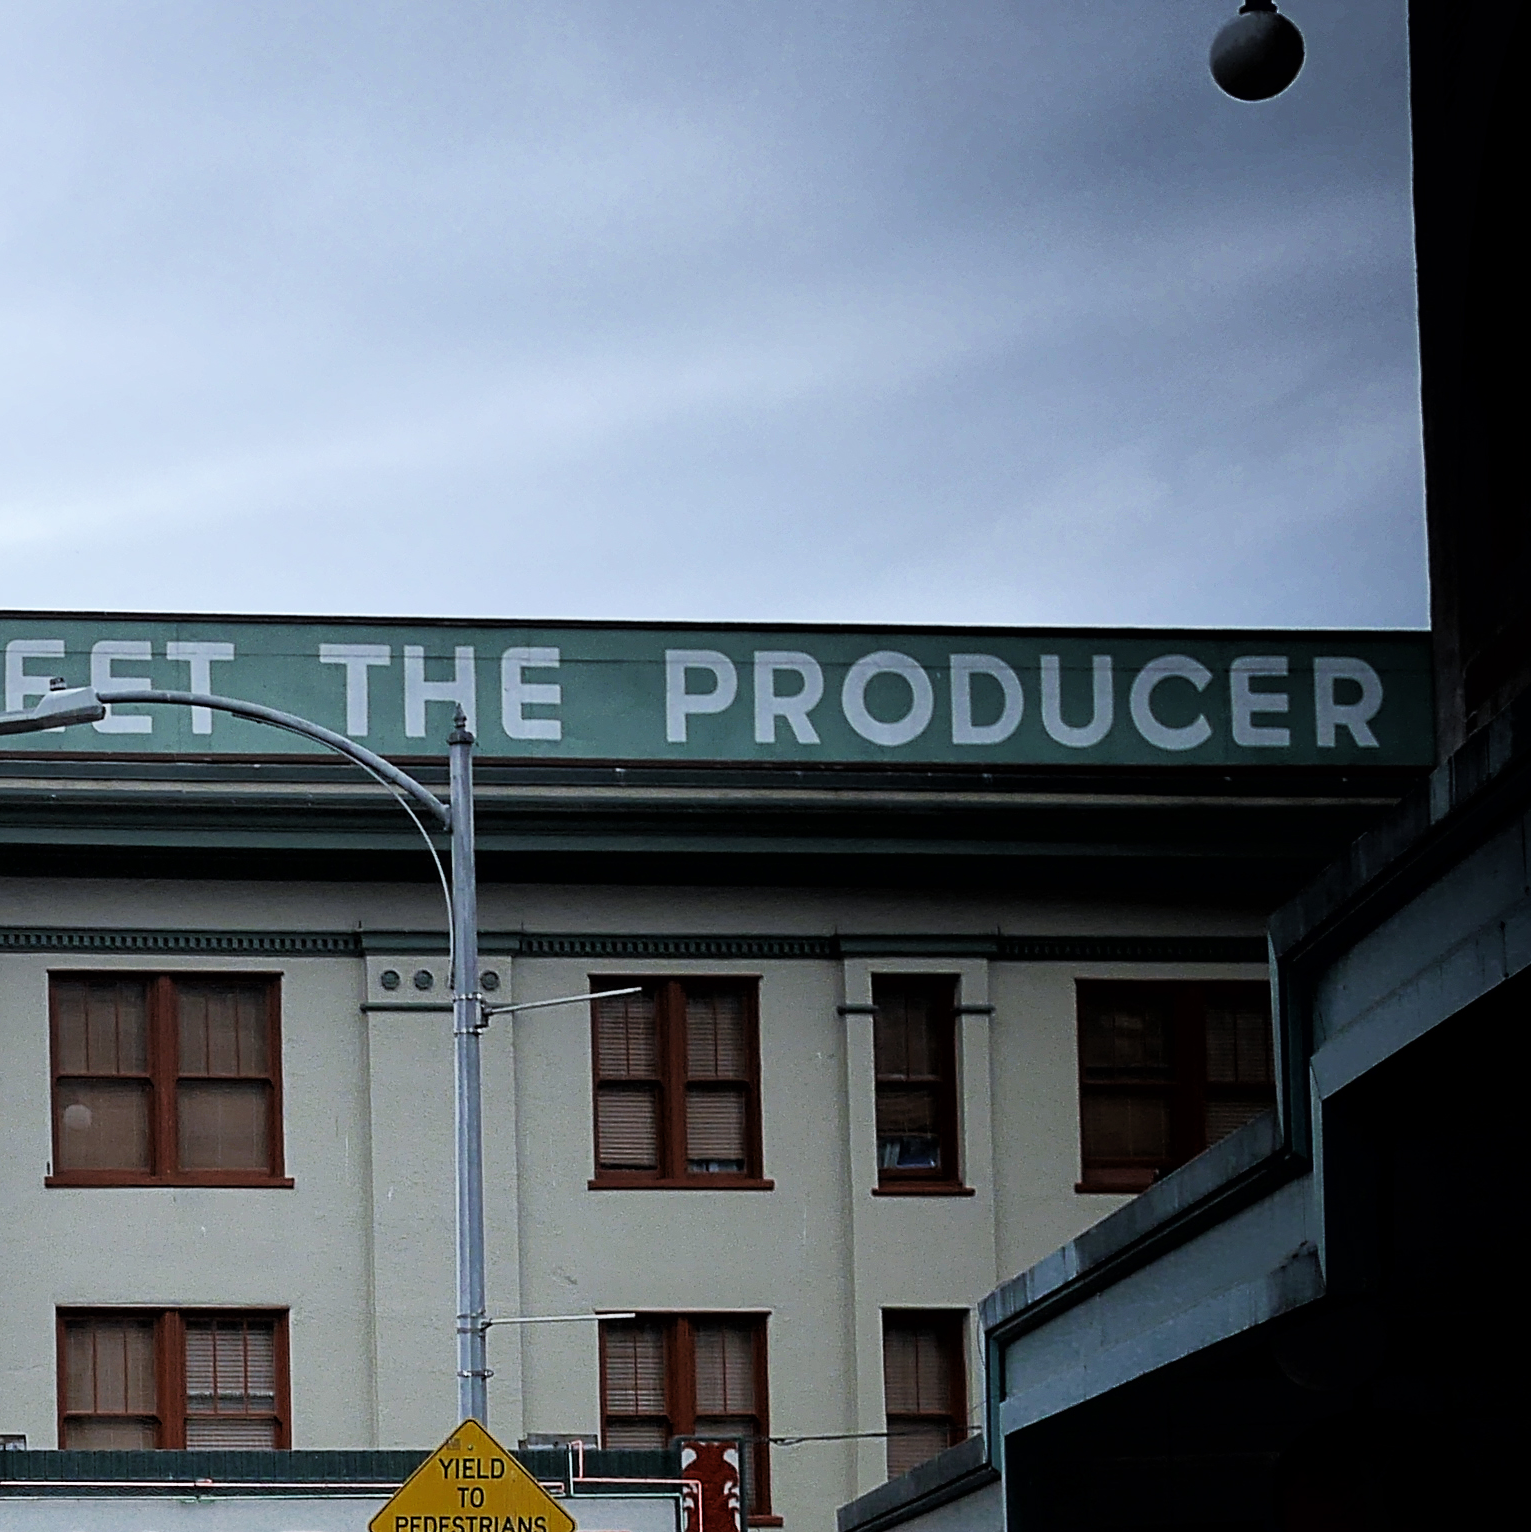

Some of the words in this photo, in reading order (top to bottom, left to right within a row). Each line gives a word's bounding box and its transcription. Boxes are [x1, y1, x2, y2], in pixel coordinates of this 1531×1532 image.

[319, 643, 563, 741] THE
[666, 647, 1385, 751] PRODUCER
[439, 1458, 506, 1480] YIELD
[457, 1487, 485, 1509] TO
